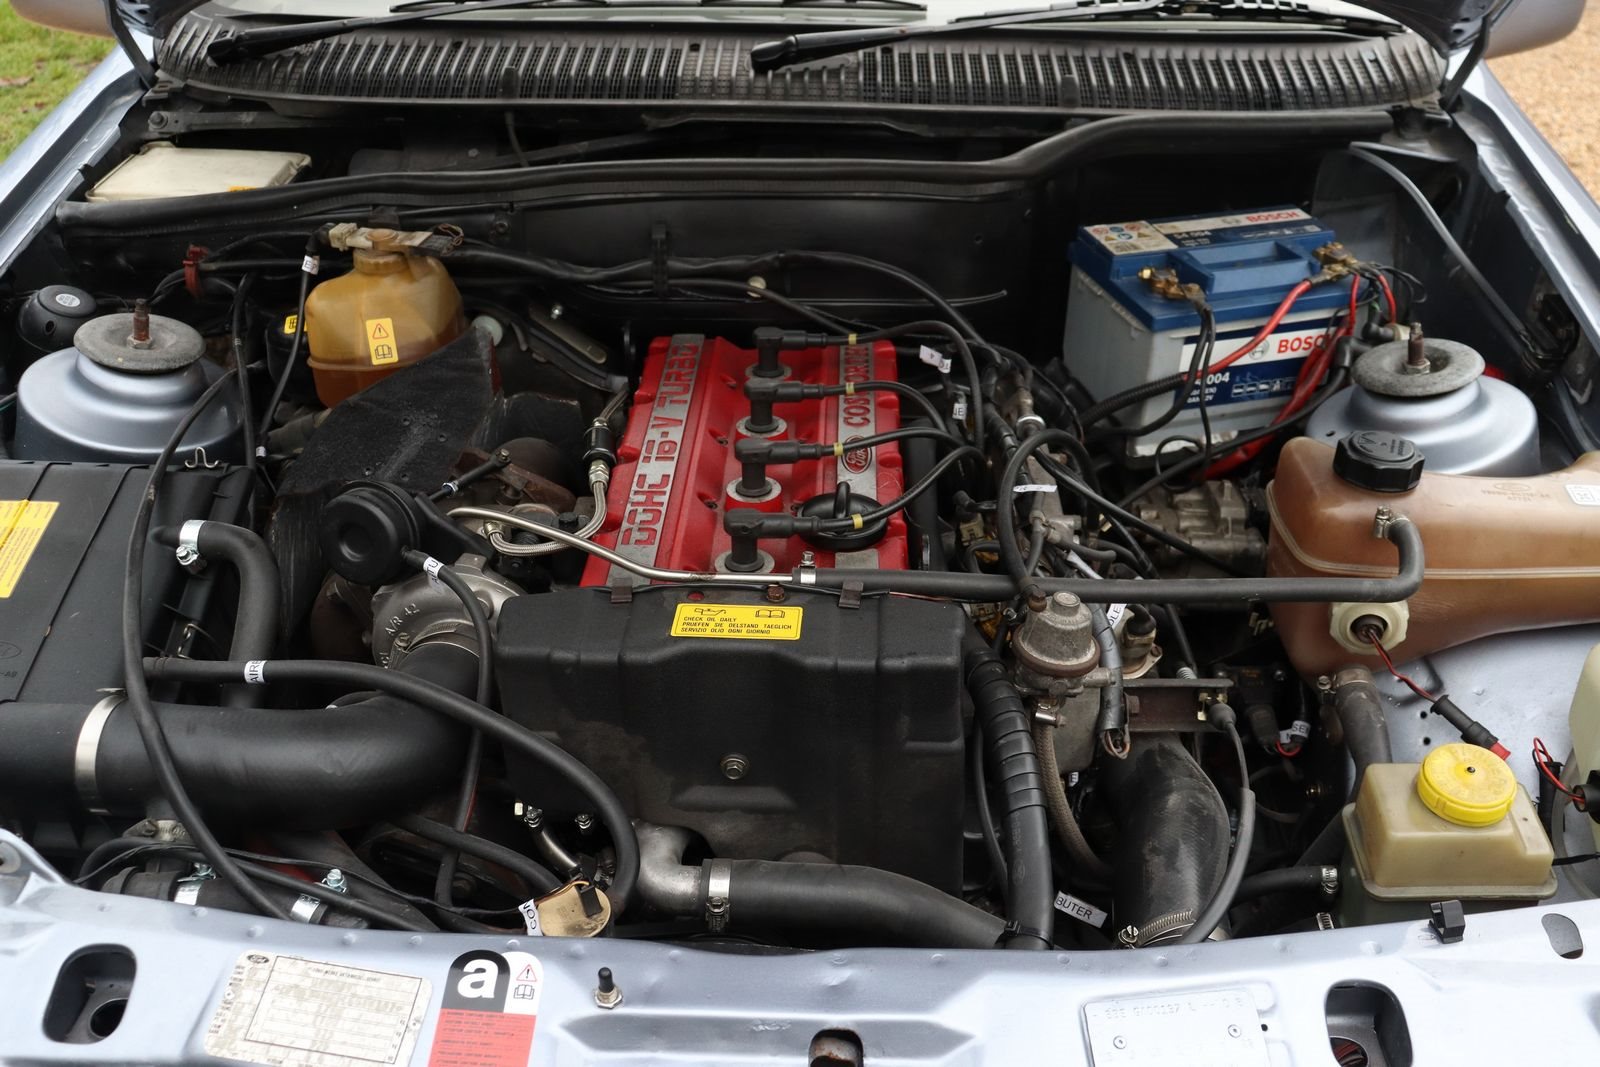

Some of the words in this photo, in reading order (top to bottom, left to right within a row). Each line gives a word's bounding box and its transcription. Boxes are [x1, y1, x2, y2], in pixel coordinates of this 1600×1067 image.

[1246, 211, 1298, 222] BOSCH
[1277, 333, 1332, 353] BOSC
[843, 344, 870, 427] COSORTH
[621, 474, 671, 545] DOHC
[656, 343, 699, 408] TURBO
[457, 959, 499, 998] a
